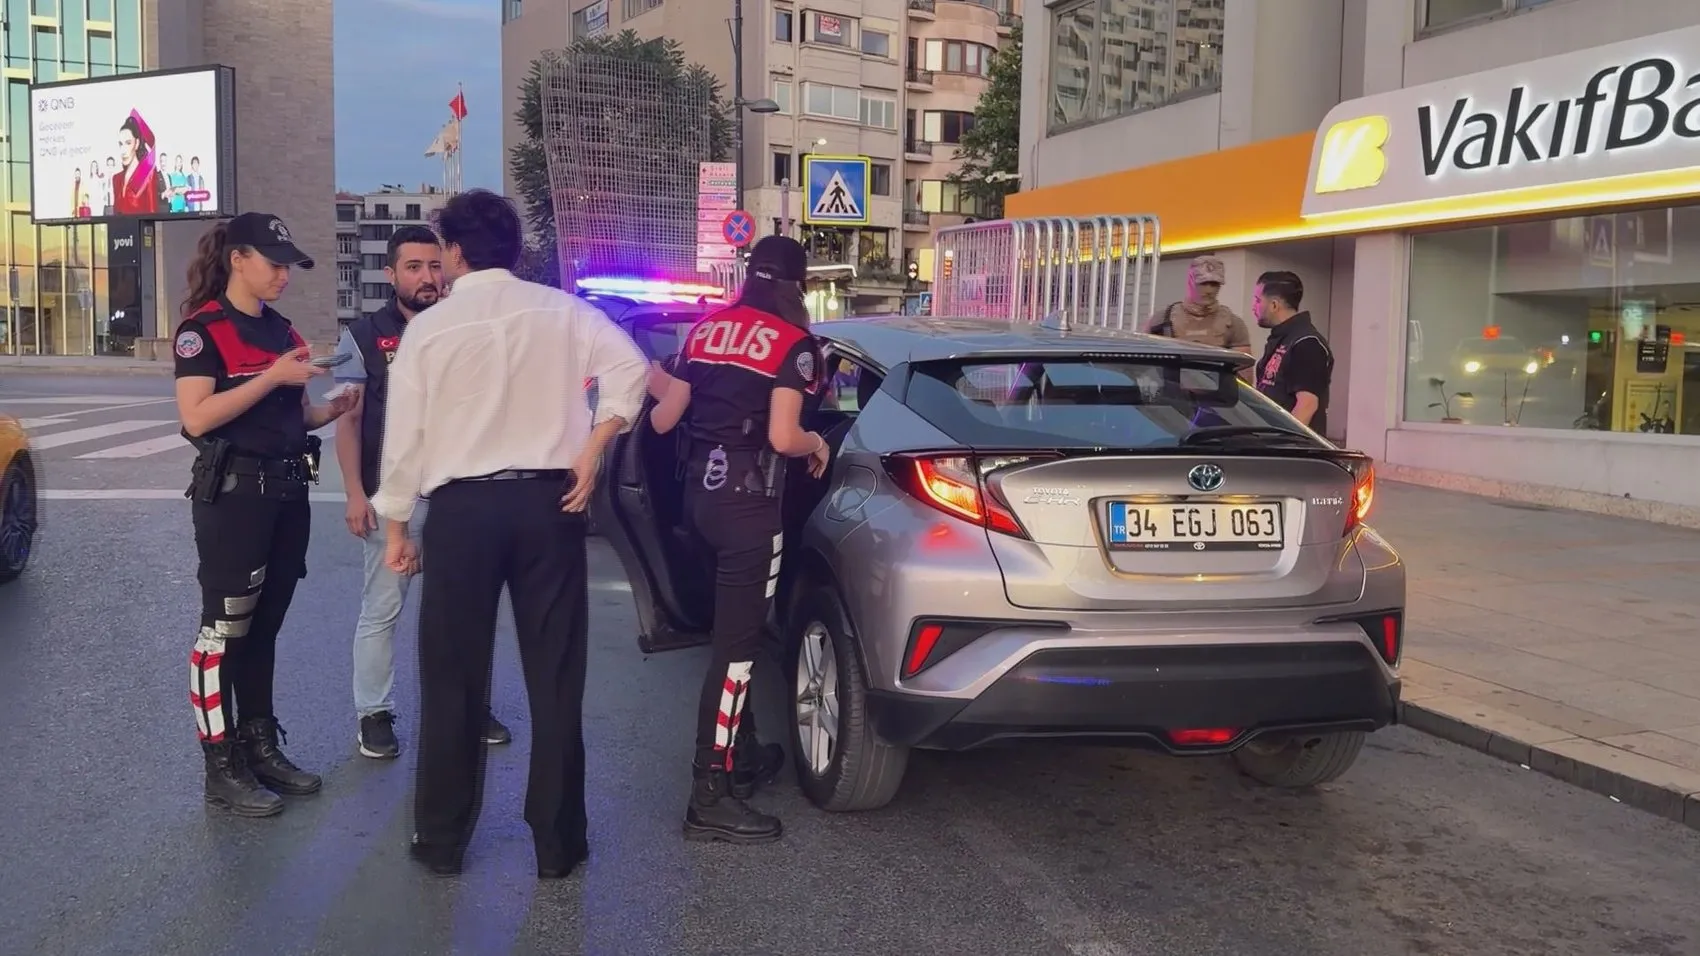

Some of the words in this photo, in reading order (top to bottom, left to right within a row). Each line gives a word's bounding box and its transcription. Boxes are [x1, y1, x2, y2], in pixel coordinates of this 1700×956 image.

[113, 235, 133, 250] yovi
[691, 320, 779, 361] POLİS
[1113, 525, 1125, 535] TR
[1128, 509, 1157, 537] 34
[1173, 508, 1217, 537] EGJ
[1231, 508, 1275, 537] 063
